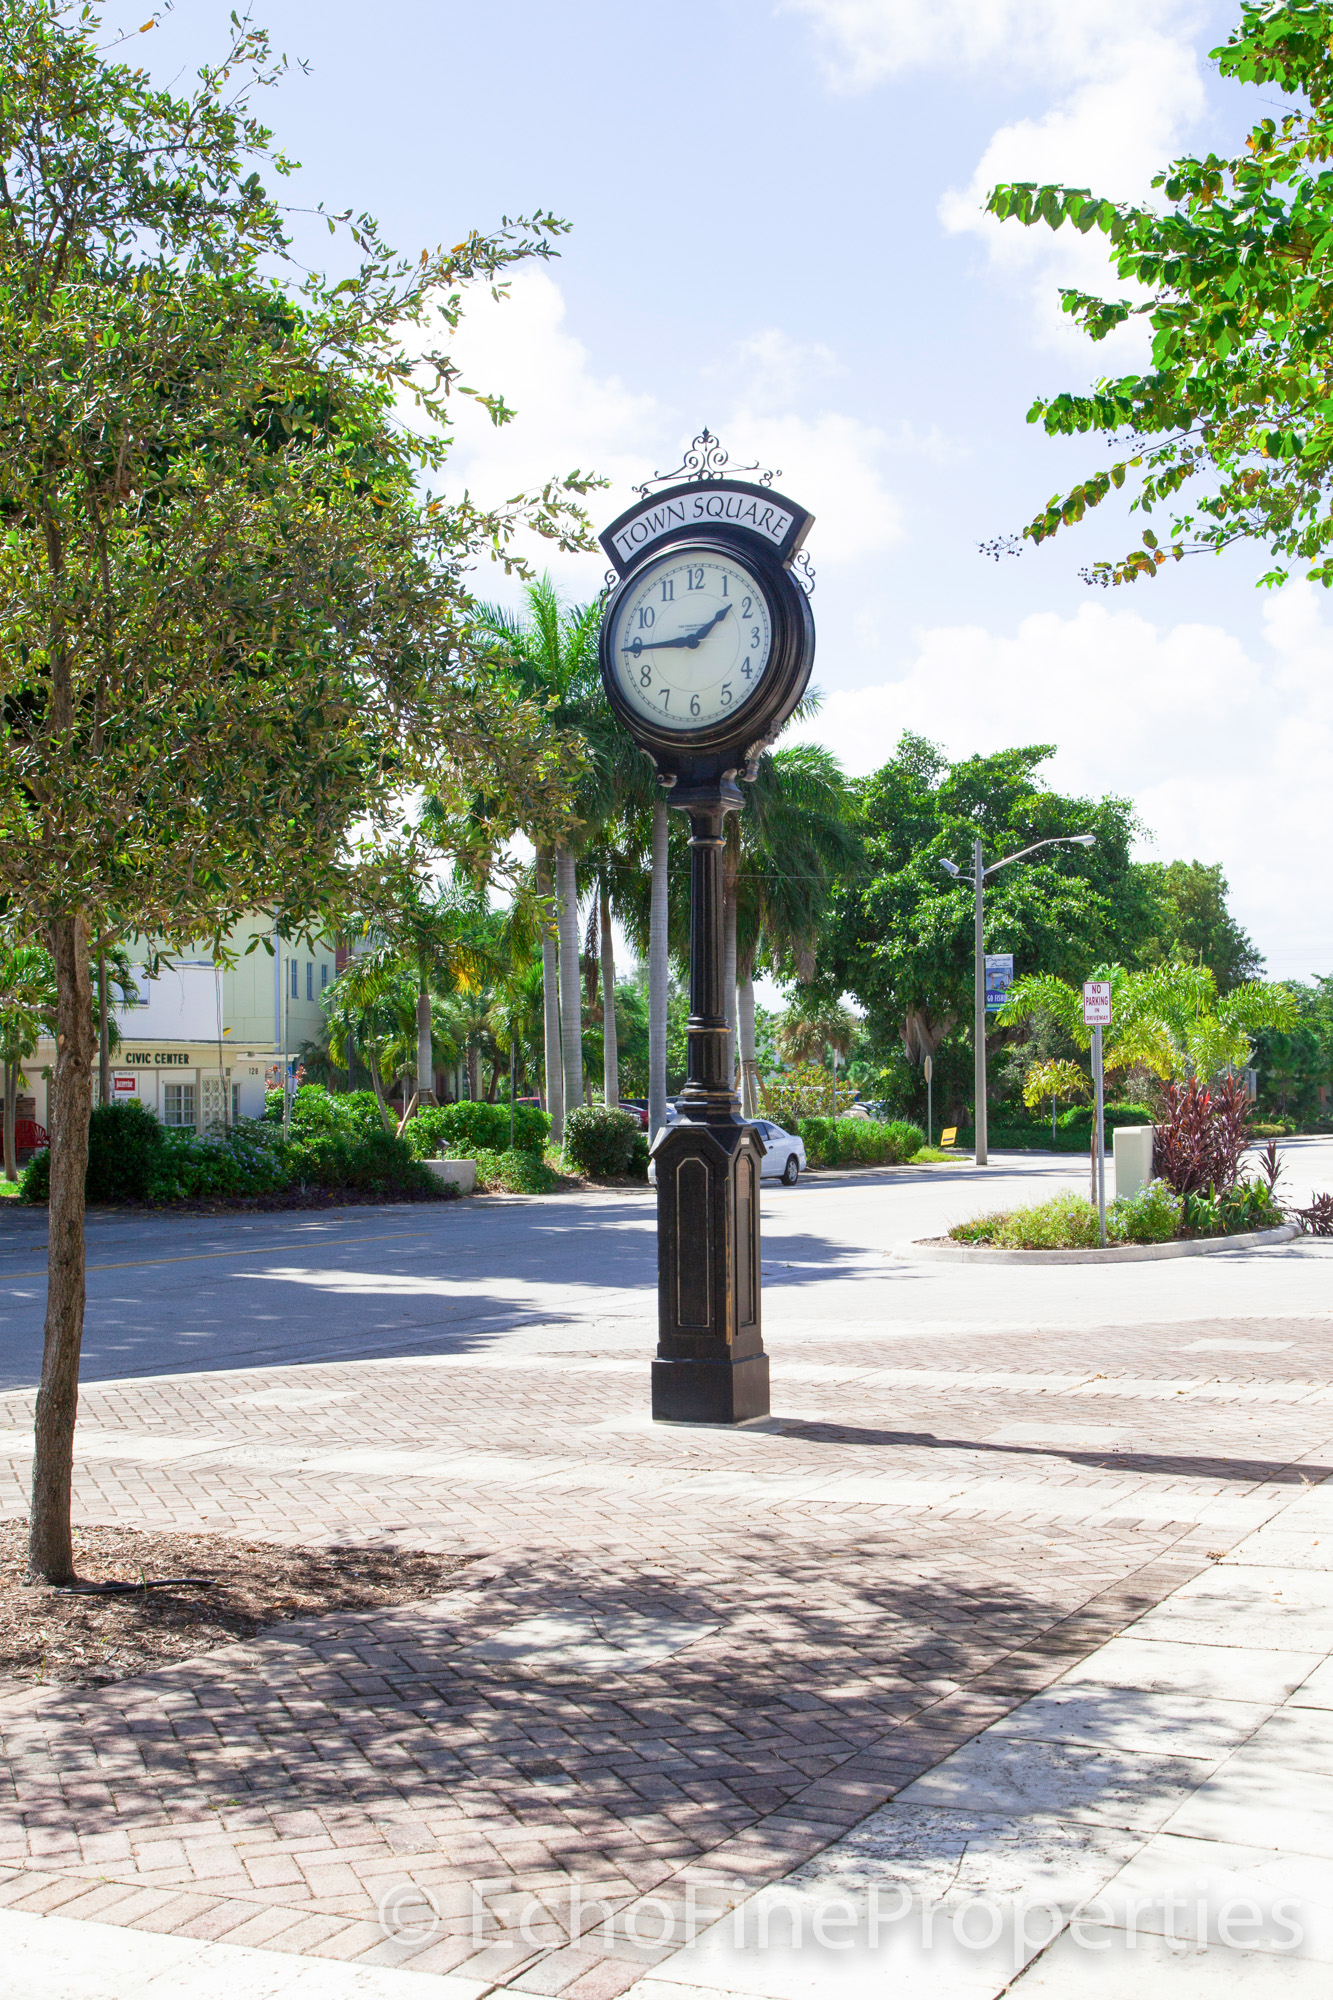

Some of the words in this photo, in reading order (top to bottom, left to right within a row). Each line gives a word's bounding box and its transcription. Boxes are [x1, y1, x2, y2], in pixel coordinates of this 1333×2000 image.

[616, 501, 686, 551] TOWN
[692, 496, 788, 538] SQUARE
[661, 579, 676, 602] 11
[686, 567, 706, 591] 12
[721, 574, 729, 597] 1
[638, 606, 655, 629] 10
[741, 596, 754, 619] 2
[750, 626, 760, 649] 3
[640, 664, 652, 688] 8
[740, 656, 753, 680] 4
[658, 688, 671, 711] 7
[720, 681, 733, 706] 5
[689, 694, 701, 717] 6
[986, 994, 994, 1002] GO
[1085, 995, 1109, 1006] PARKING
[1091, 984, 1102, 994] NO
[126, 1052, 152, 1064] CIVIC
[154, 1052, 190, 1065] CENTER
